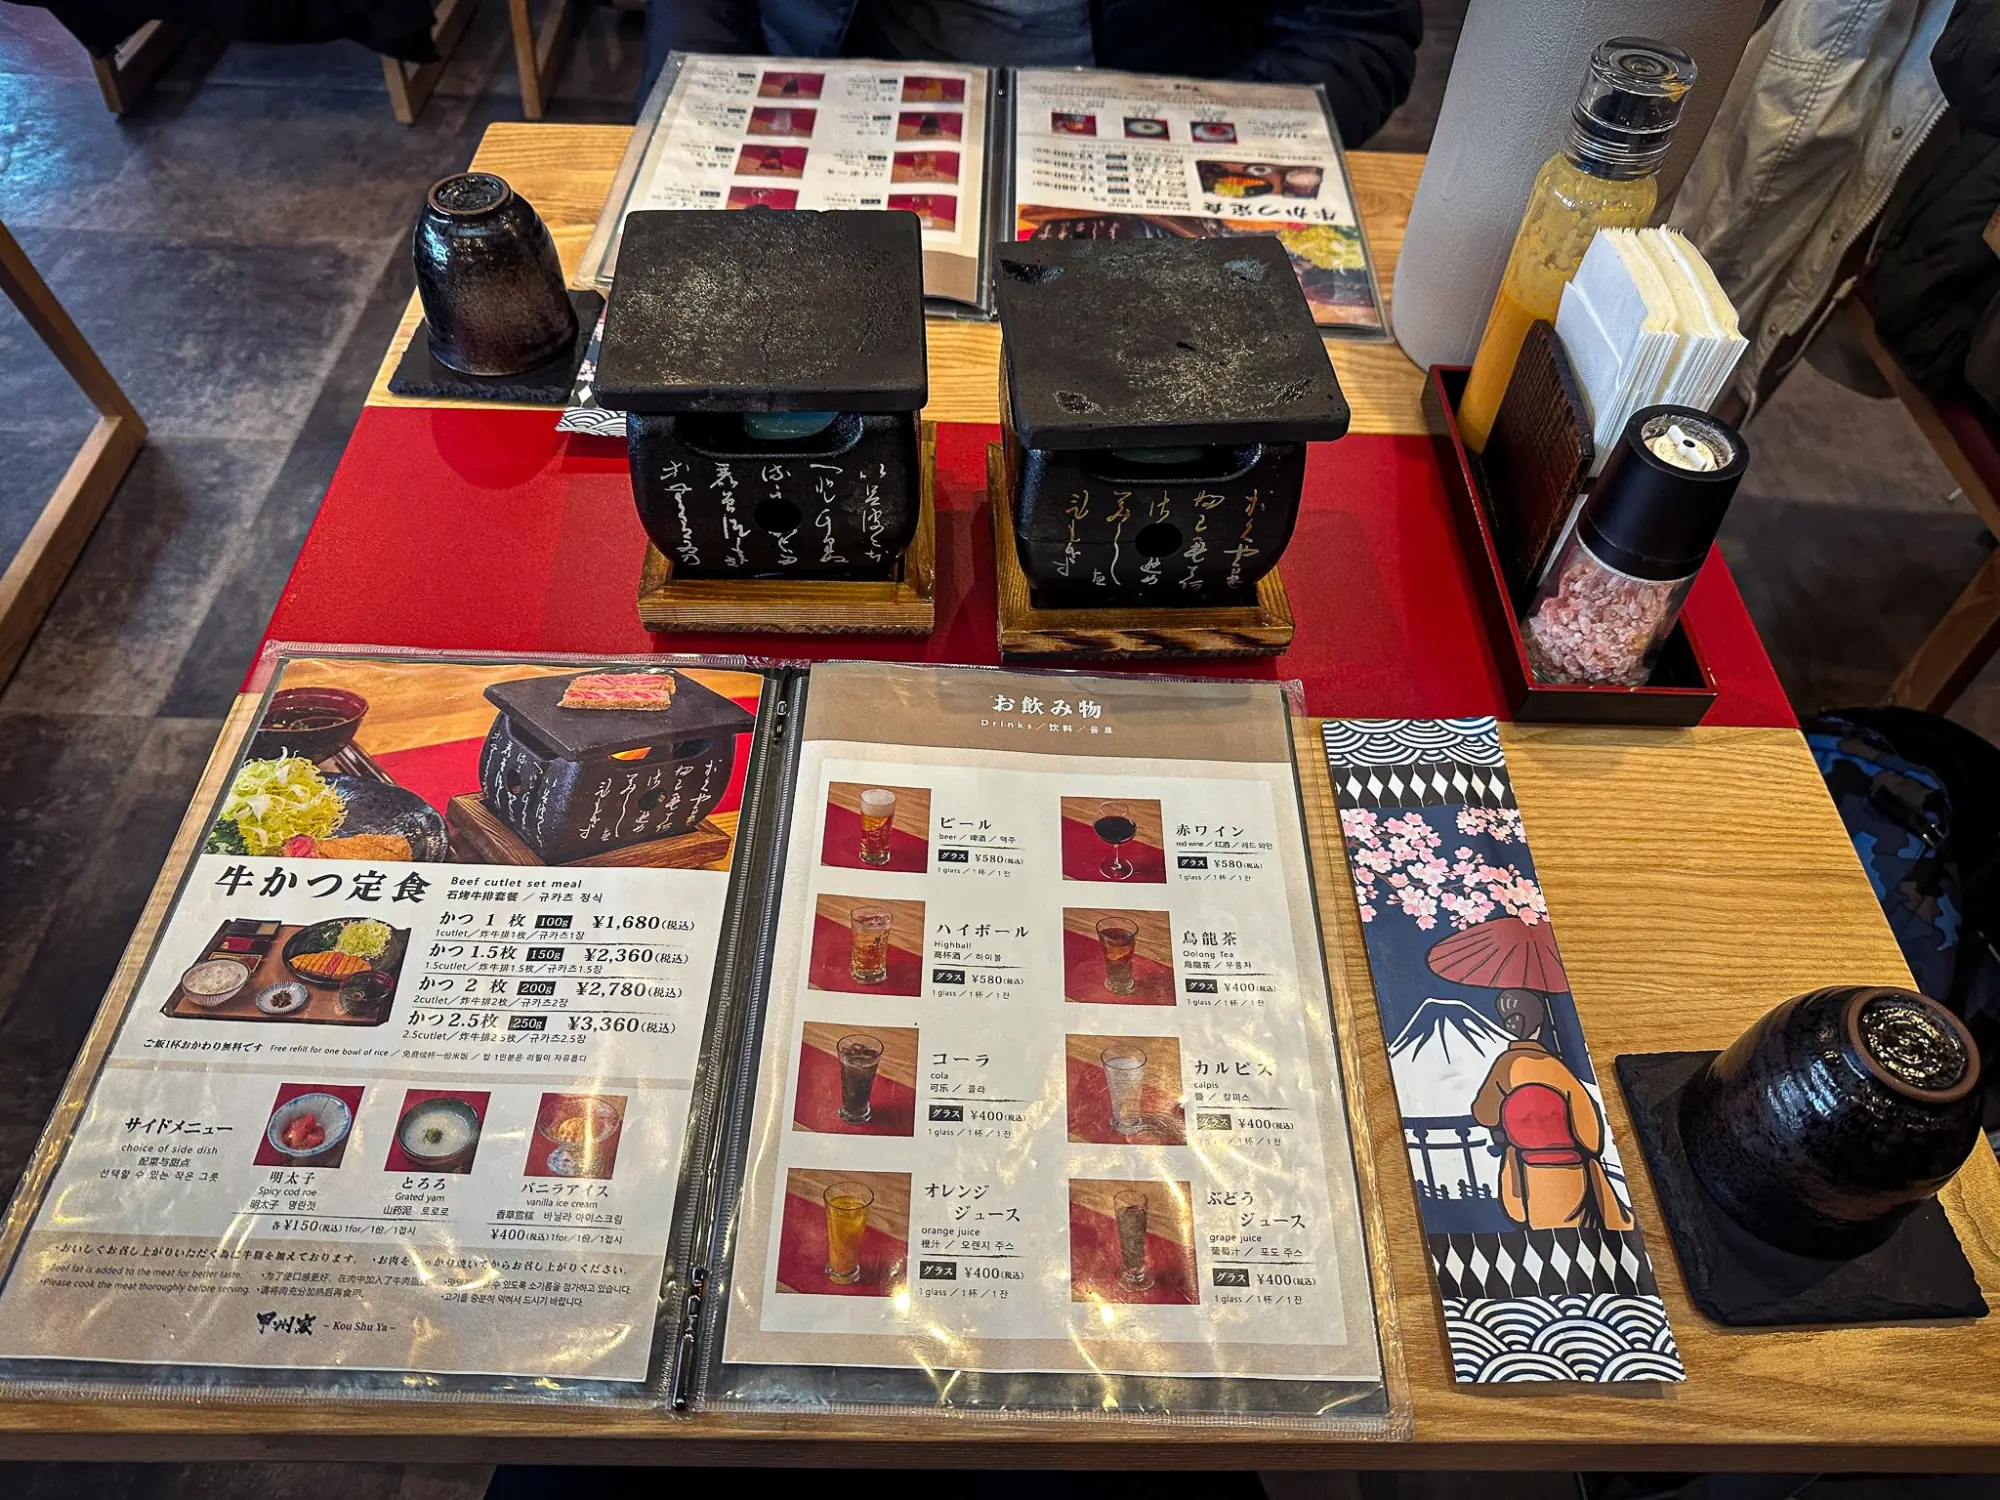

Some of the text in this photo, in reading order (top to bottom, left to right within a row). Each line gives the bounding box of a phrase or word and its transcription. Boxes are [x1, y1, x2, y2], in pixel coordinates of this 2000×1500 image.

[991, 694, 1102, 719] お飲み物
[980, 719, 1033, 730] Drinks
[940, 816, 992, 830] ビール
[1176, 823, 1244, 838] 赤ワイン
[941, 851, 966, 861] グラス
[1180, 859, 1206, 867] グラス
[215, 864, 432, 903] 牛かつ定食
[450, 876, 583, 889] Beef cutlet set meal
[538, 892, 573, 902] 규카츠
[579, 892, 603, 903] 정식
[539, 916, 570, 928] 100g
[936, 923, 1029, 938] ハイボール
[934, 941, 972, 950] Highball
[531, 949, 562, 961] 150g
[1182, 950, 1215, 959] Oolong
[935, 972, 962, 981] グラス
[520, 983, 553, 995] 200g
[1188, 981, 1215, 990] グラス
[511, 1017, 543, 1030] 250g
[270, 1044, 287, 1052] Free
[289, 1045, 308, 1053] refill
[310, 1045, 322, 1054] for
[342, 1048, 361, 1056] bowl
[363, 1048, 372, 1056] of
[374, 1049, 389, 1057] rice
[932, 1053, 989, 1068] コーラ
[1194, 1060, 1273, 1076] カルピス
[930, 1072, 949, 1080] cola
[930, 1083, 949, 1093] 可乐
[1193, 1081, 1219, 1090] calpis
[931, 1108, 960, 1118] グラス
[125, 1117, 233, 1135] サイドメニュー
[121, 1143, 218, 1155] choice of side dish
[135, 1170, 144, 1180] 수
[149, 1170, 169, 1181] 있는
[269, 1170, 315, 1185] 明太子
[402, 1176, 446, 1190] とろろ
[258, 1186, 317, 1197] Spicy cod roe
[521, 1181, 608, 1198] バニラアイス
[925, 1183, 989, 1200] オレンジ
[394, 1192, 445, 1203] Grated yam
[1206, 1191, 1254, 1206] ぶどう
[249, 1199, 279, 1210] 明太子
[526, 1198, 598, 1209] vanilla ice cream
[543, 1211, 572, 1222] 바닐라
[955, 1205, 1020, 1222] ジュース
[1240, 1212, 1306, 1229] ジュース
[921, 1226, 981, 1237] orange juice
[1210, 1234, 1262, 1243] grape juice
[921, 1239, 1014, 1250] 橙汁 오렌지 주스
[1284, 1248, 1303, 1258] 주스
[71, 1264, 84, 1273] fat
[85, 1266, 93, 1274] is
[95, 1266, 123, 1275] added
[125, 1267, 135, 1276] to
[136, 1267, 150, 1276] the
[152, 1268, 175, 1277] meat
[176, 1268, 190, 1277] for
[192, 1269, 218, 1278] better
[923, 1265, 953, 1276] グラス
[1216, 1272, 1246, 1283] グラス
[43, 1278, 251, 1295] Please cook the meat thoroughly before serving.
[333, 1321, 388, 1332] Kou Shu Ya
